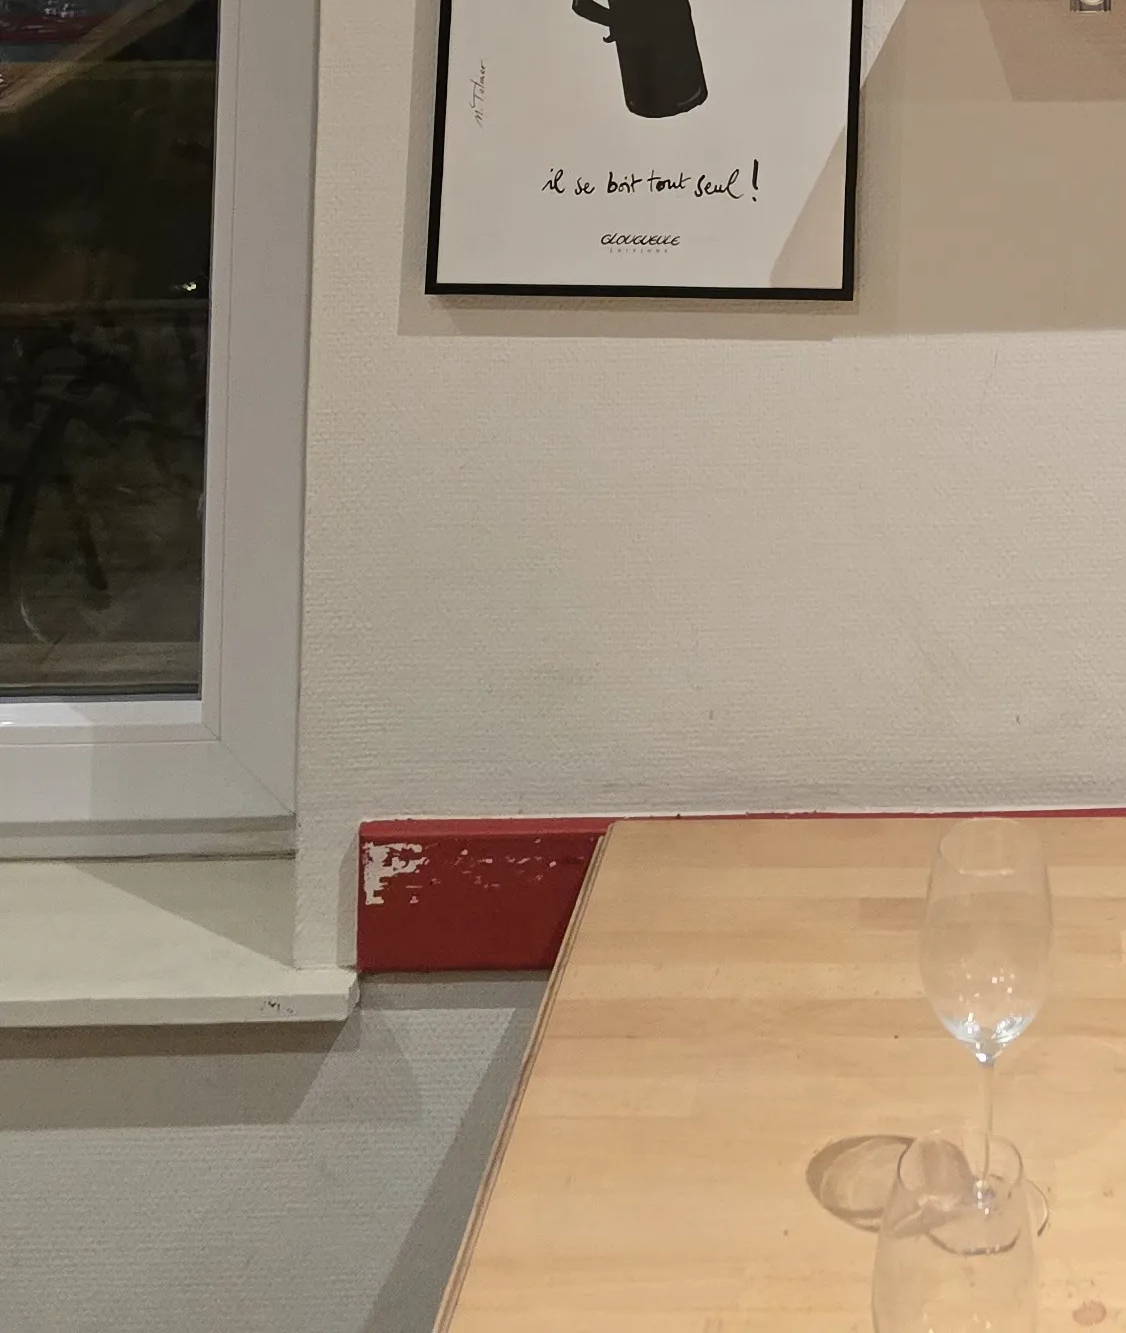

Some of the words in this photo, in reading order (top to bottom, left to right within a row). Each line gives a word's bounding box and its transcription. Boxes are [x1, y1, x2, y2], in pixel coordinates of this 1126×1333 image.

[541, 168, 566, 194] il
[574, 176, 595, 195] se
[606, 171, 643, 194] boit
[647, 170, 692, 192] tout
[693, 169, 744, 199] seul
